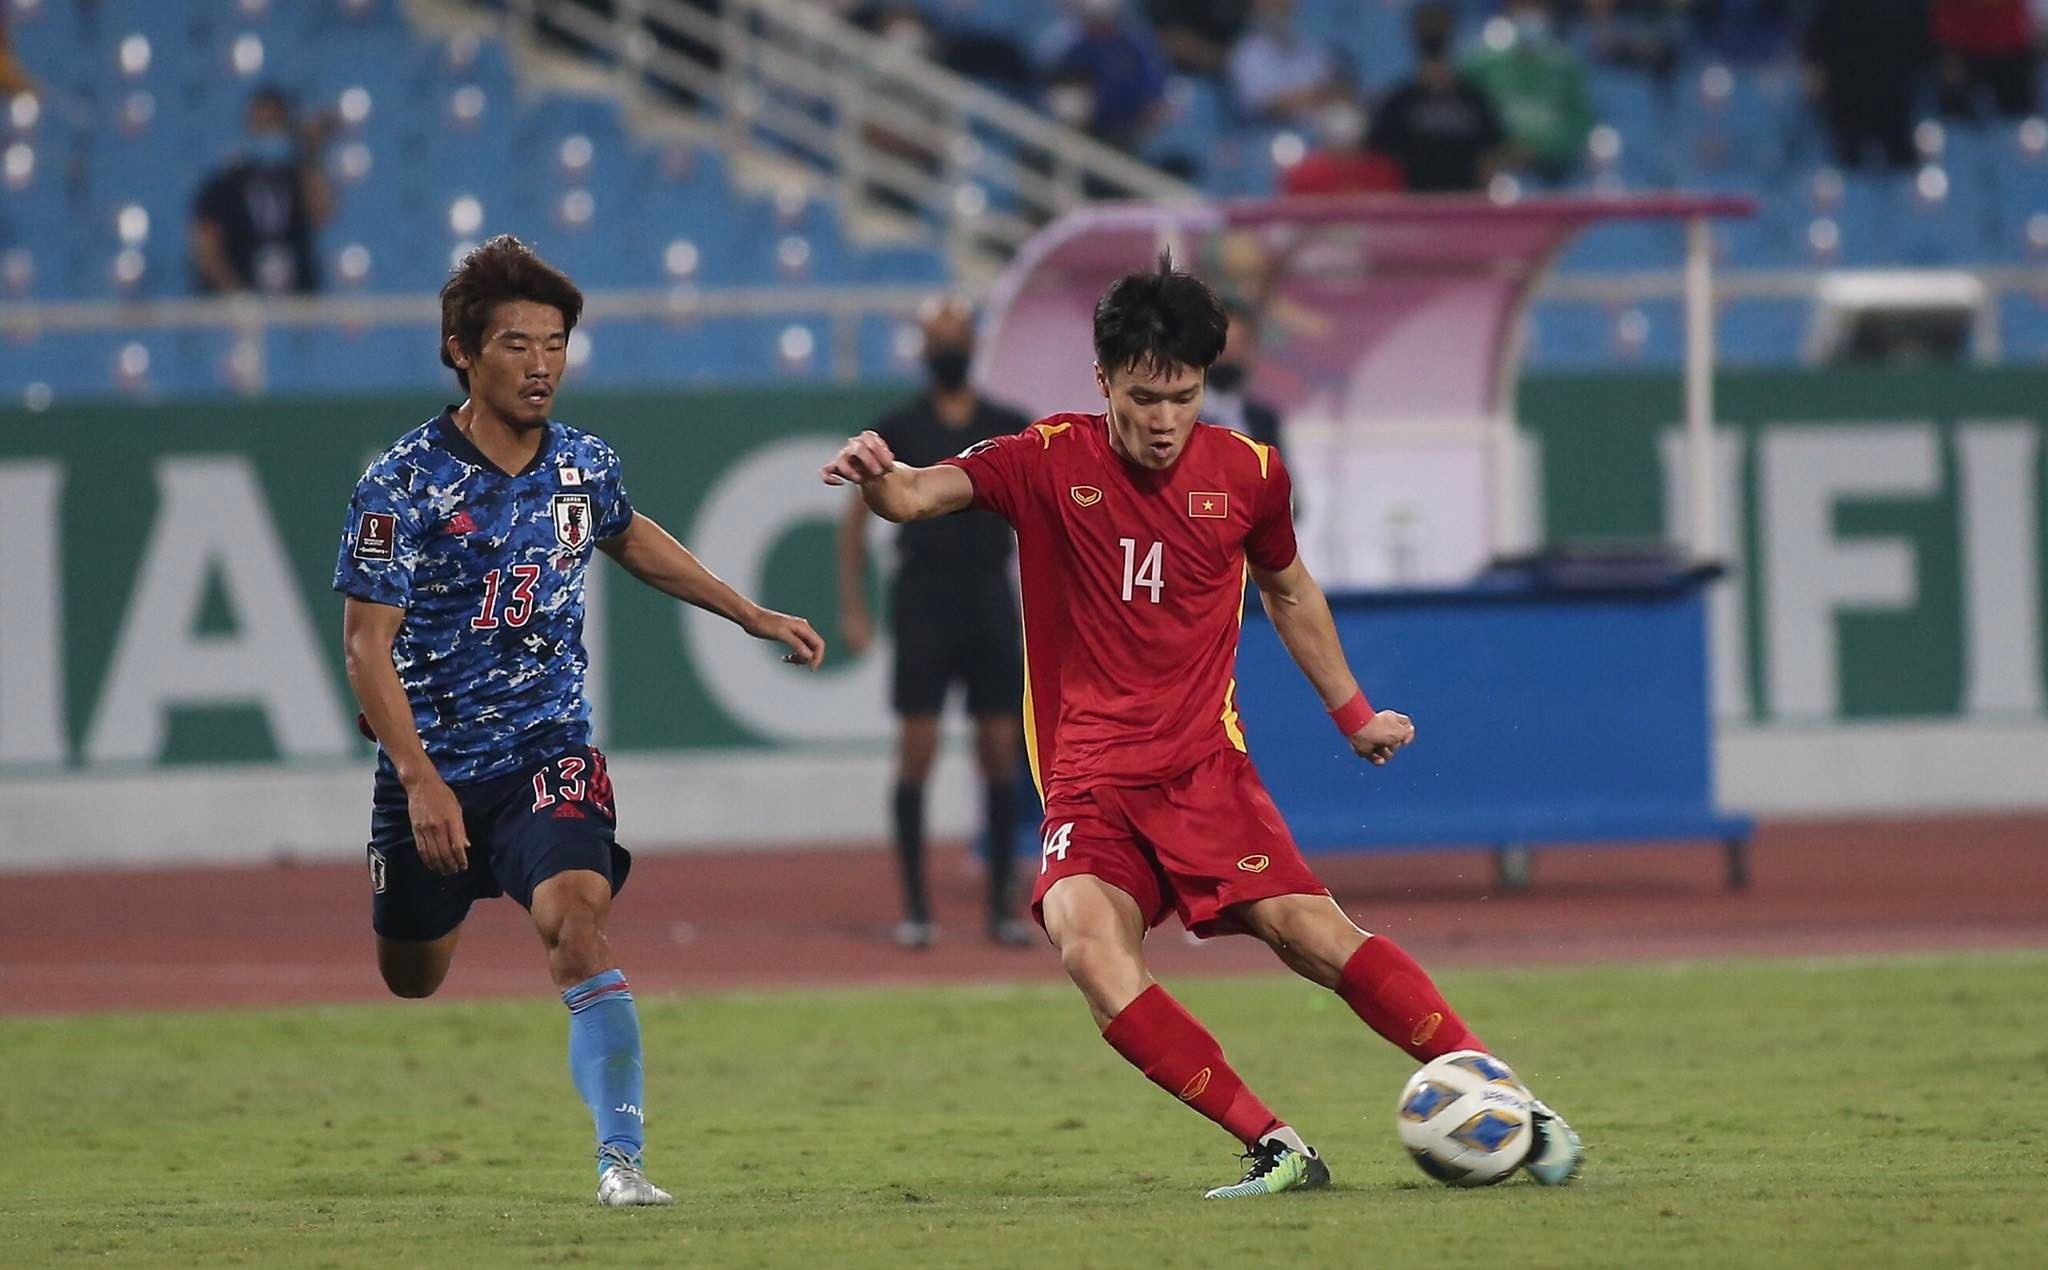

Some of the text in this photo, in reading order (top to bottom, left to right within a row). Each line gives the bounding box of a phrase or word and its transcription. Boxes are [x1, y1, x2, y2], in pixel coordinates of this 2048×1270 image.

[470, 564, 541, 630] 13
[1119, 537, 1165, 604] 14
[531, 756, 586, 814] 13
